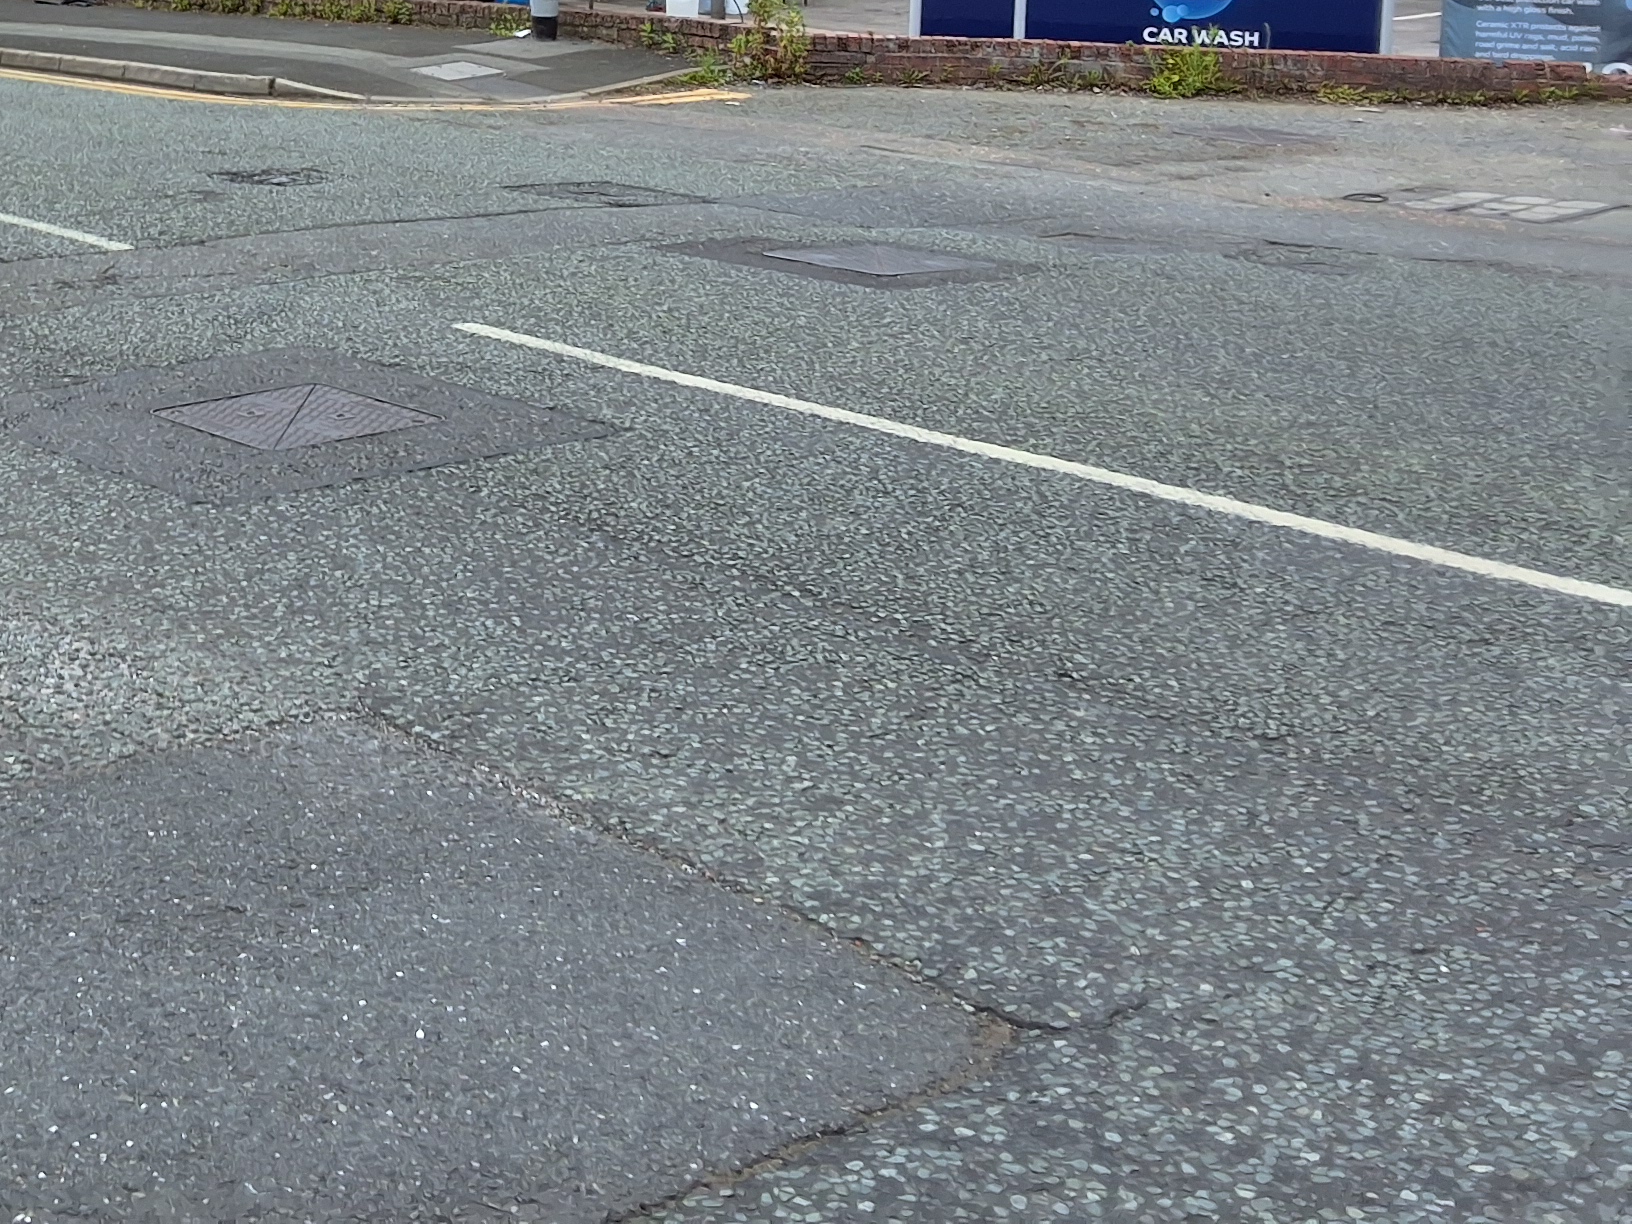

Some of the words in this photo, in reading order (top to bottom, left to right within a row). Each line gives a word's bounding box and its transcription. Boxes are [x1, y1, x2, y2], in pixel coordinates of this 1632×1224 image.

[1475, 20, 1508, 28] Ceramic
[1510, 21, 1529, 29] XTR
[1142, 26, 1188, 44] CAR
[1190, 26, 1260, 47] WASH
